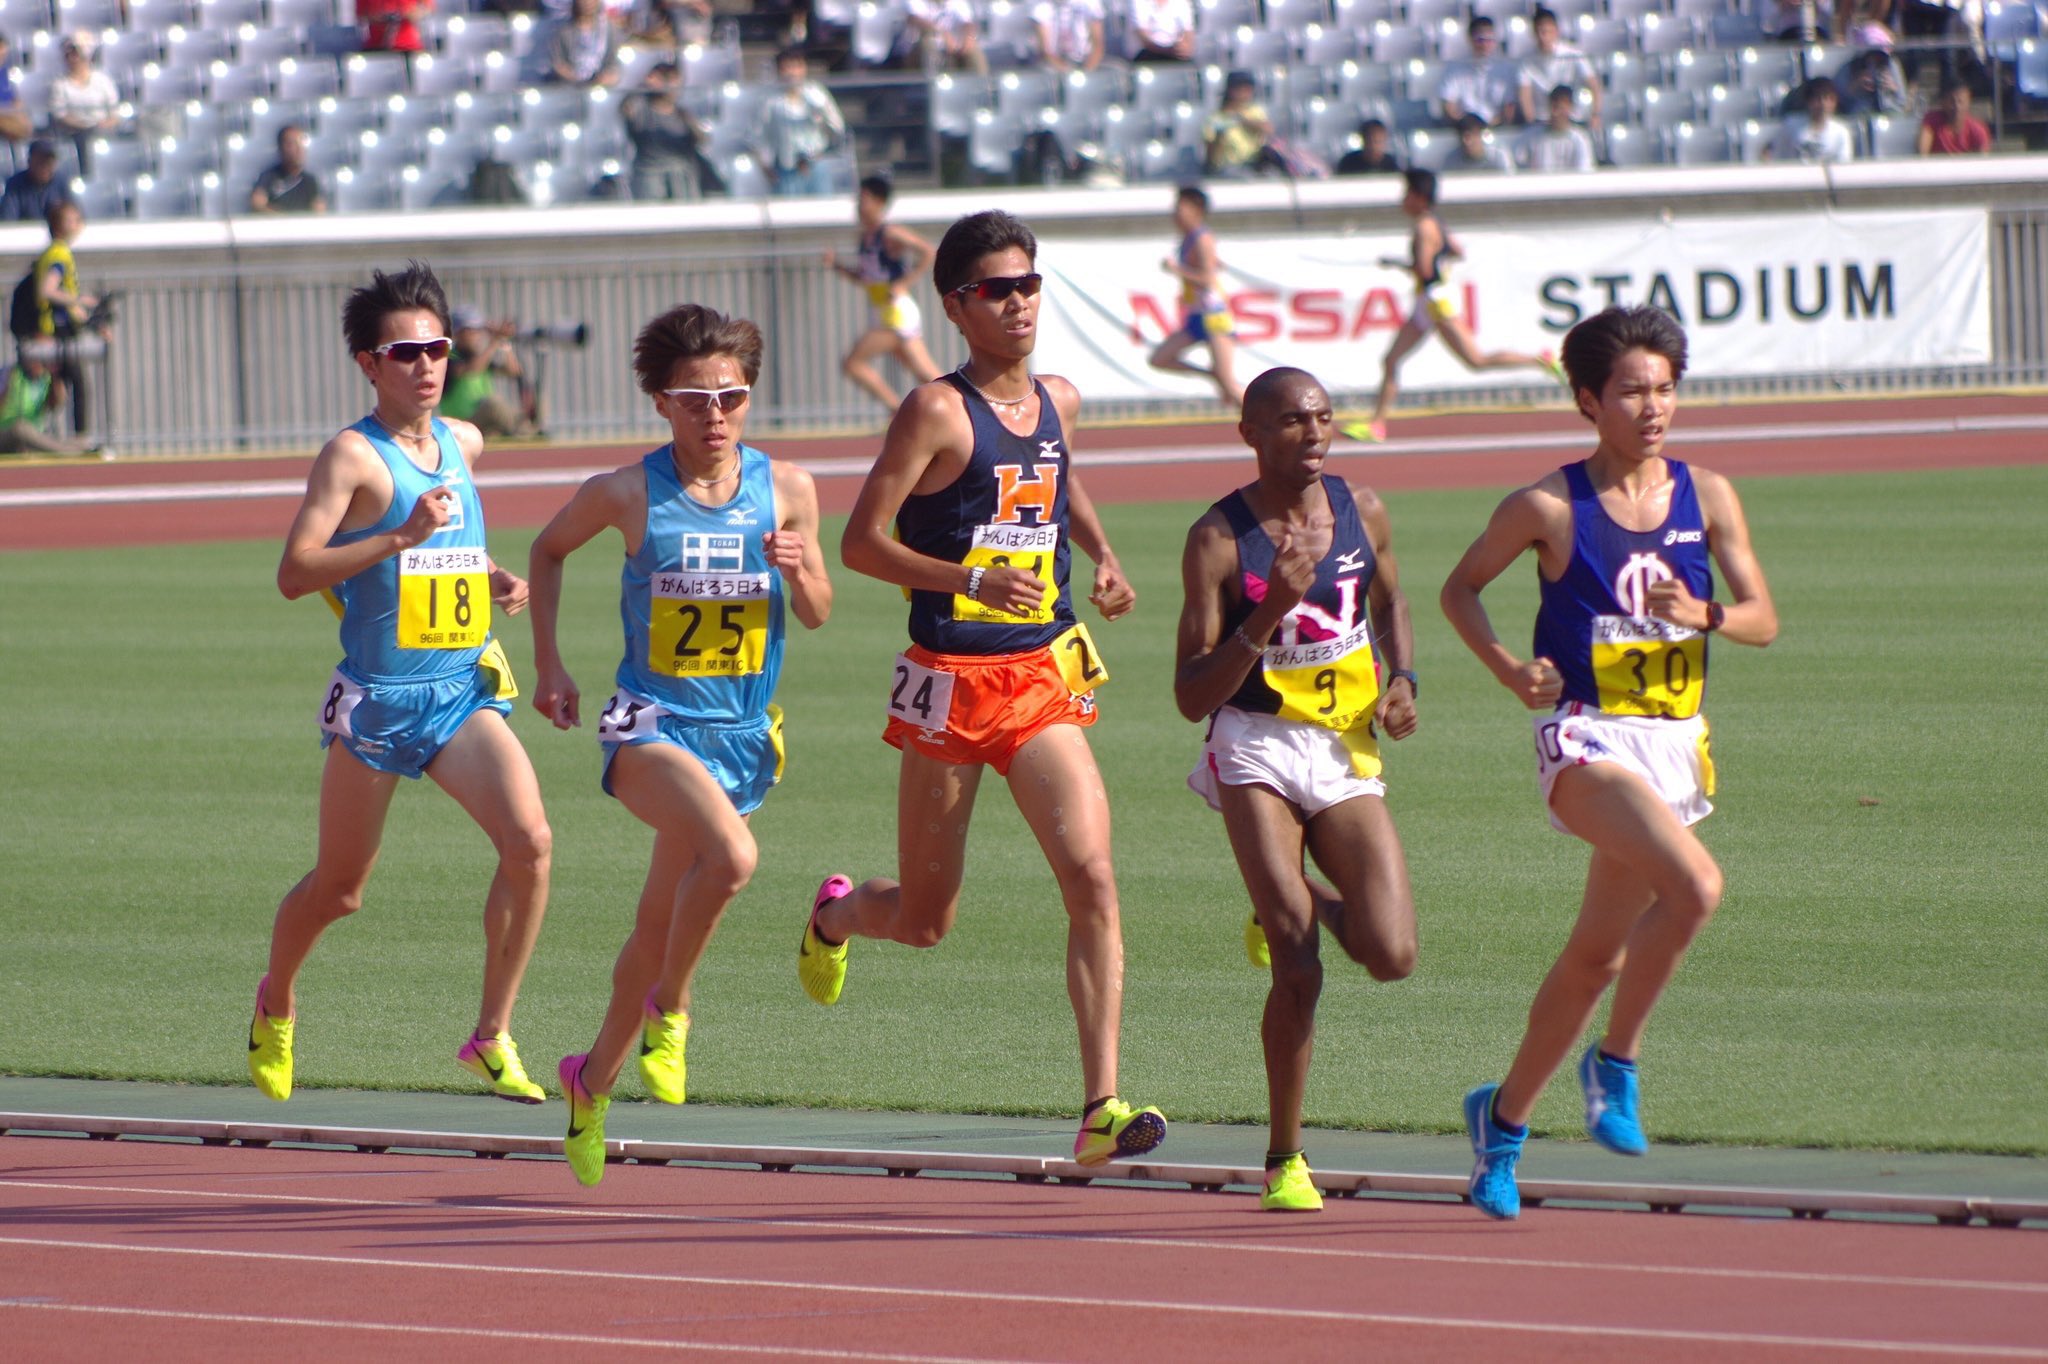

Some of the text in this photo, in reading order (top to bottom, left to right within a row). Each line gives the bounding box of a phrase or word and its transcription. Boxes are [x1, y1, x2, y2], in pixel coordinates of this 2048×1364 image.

[1128, 262, 1895, 347] NSSA STADIUM
[991, 463, 1059, 525] H
[407, 553, 481, 570] がんばろう日本
[712, 540, 736, 548] TOKAI
[429, 577, 472, 629] 18
[660, 578, 765, 595] がんばろう日本
[675, 604, 745, 657] 25
[1272, 630, 1366, 666] がんばろう日本
[673, 659, 744, 671] 96回 関東IC
[1065, 636, 1103, 682] 2
[1623, 646, 1690, 697] 30
[891, 665, 934, 720] 24
[1314, 668, 1337, 715] 9
